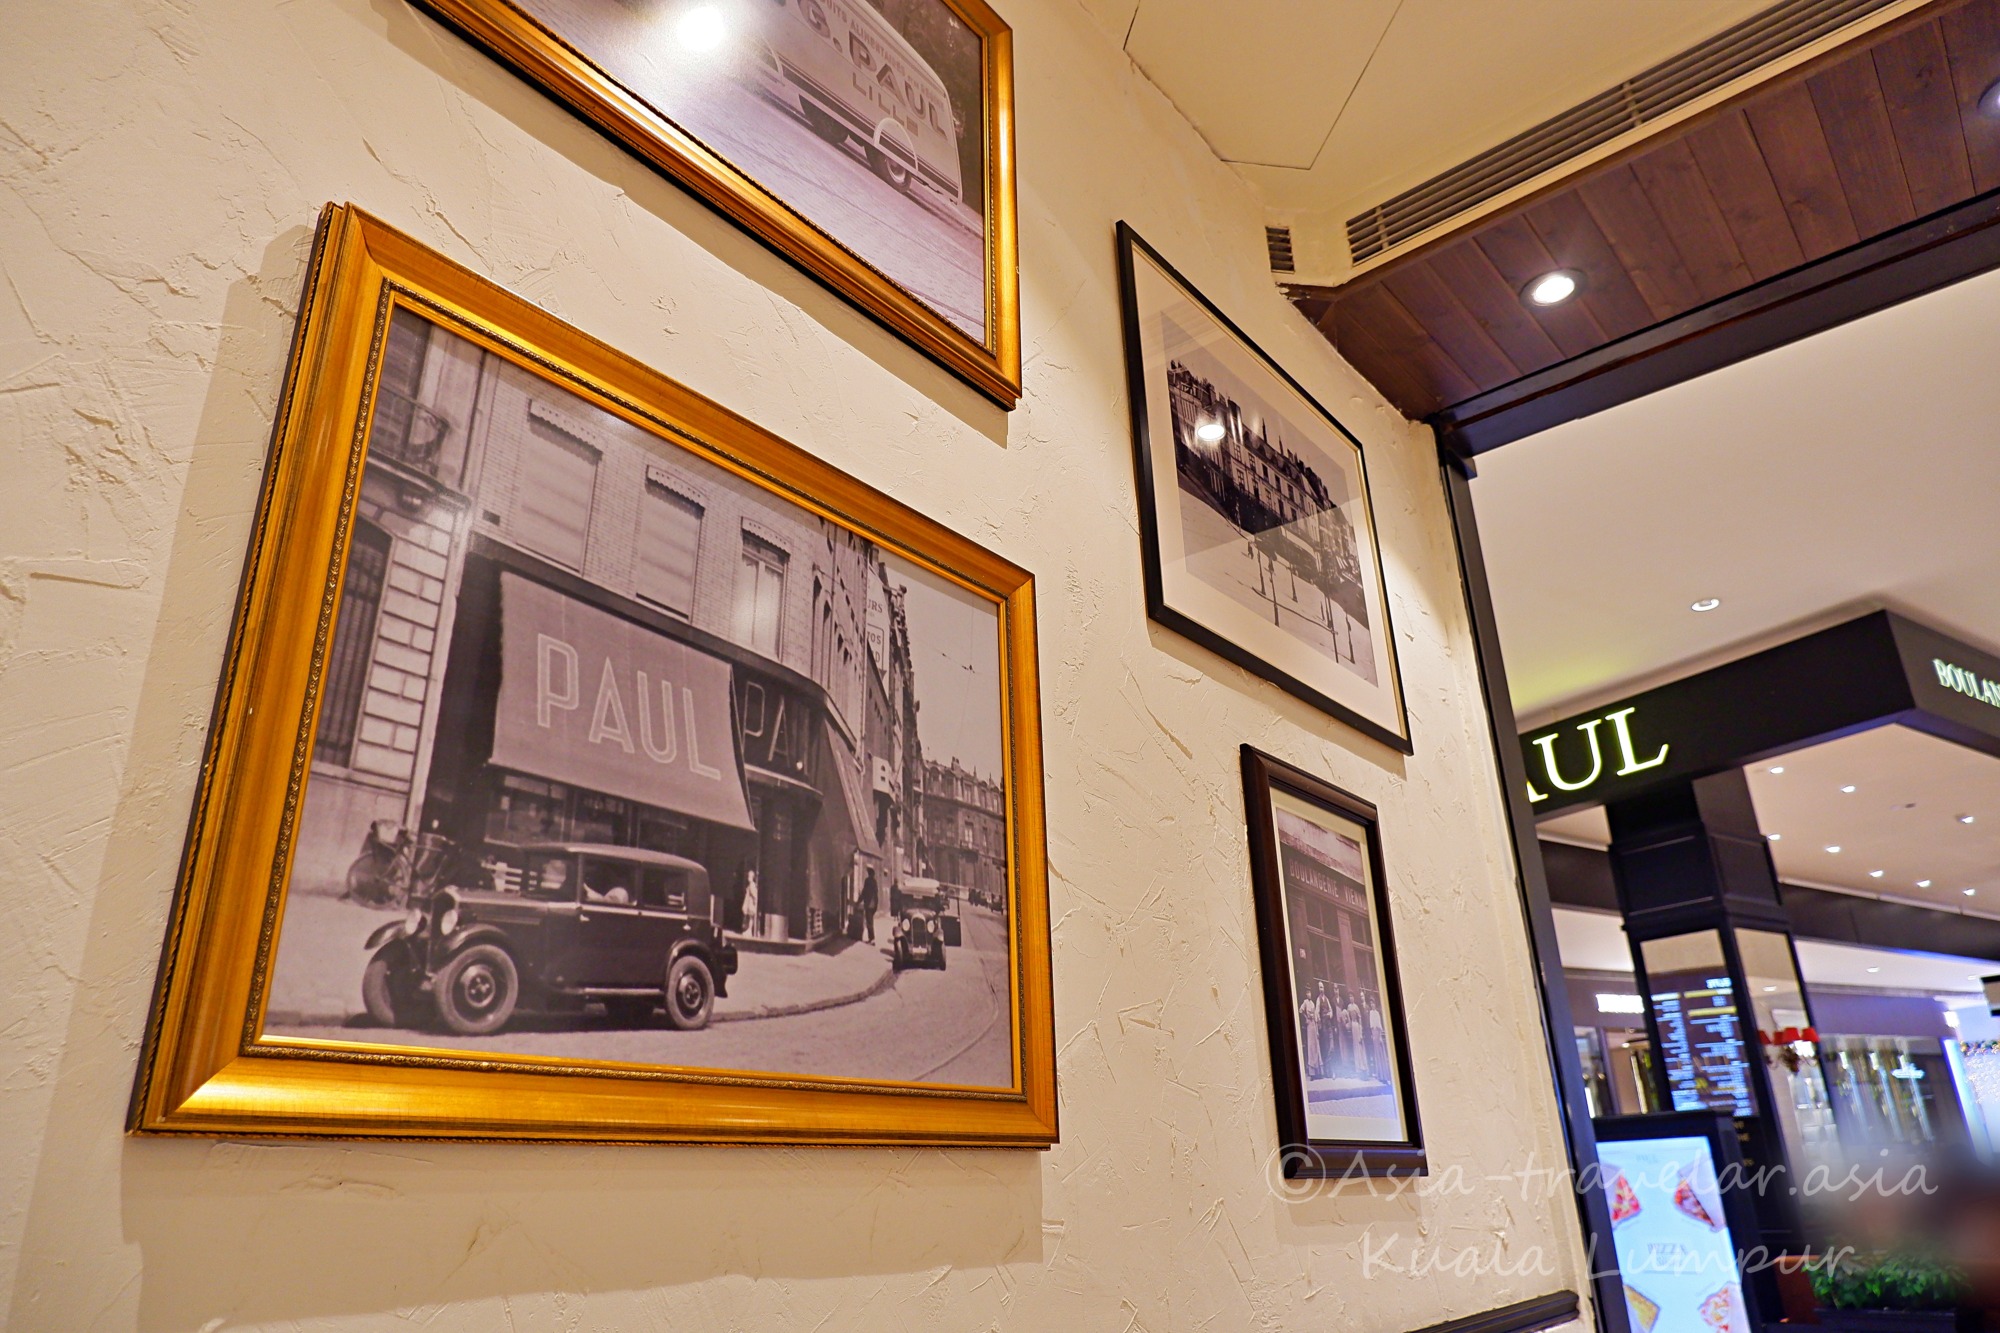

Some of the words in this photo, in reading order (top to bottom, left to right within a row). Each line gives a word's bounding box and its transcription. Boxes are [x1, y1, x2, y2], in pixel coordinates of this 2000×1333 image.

[853, 72, 919, 137] LILLE
[537, 632, 722, 781] PAUL
[1526, 706, 1670, 803] UL
[1289, 858, 1339, 898] BOULANGERIE
